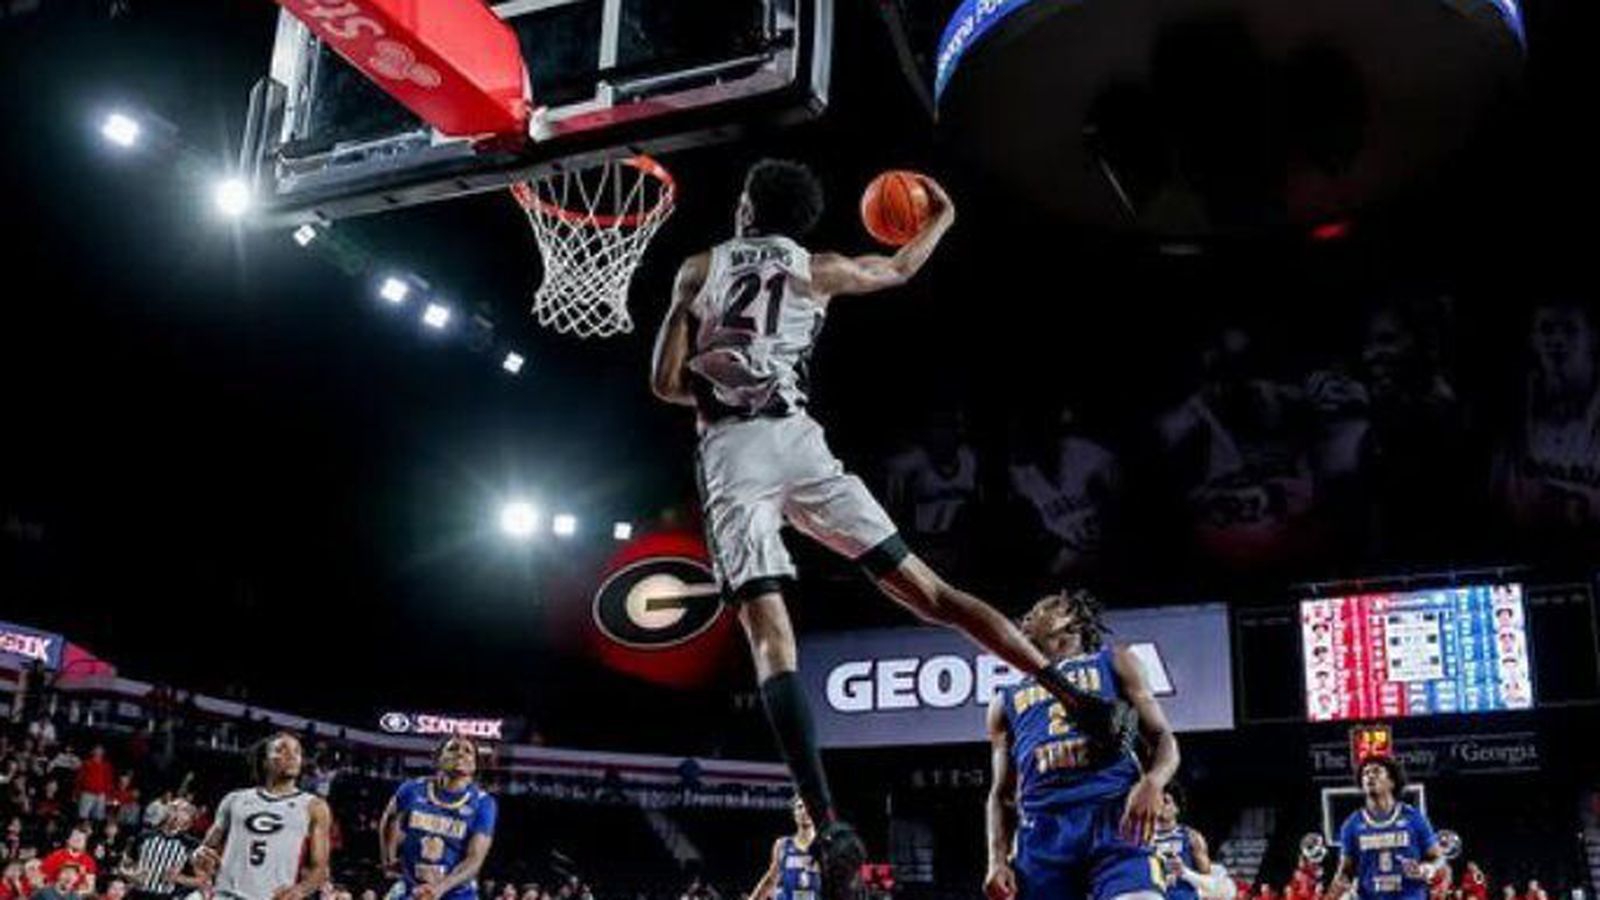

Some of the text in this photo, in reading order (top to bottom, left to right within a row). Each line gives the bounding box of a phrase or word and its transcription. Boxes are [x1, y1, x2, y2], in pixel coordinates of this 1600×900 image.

[721, 272, 787, 337] 21
[592, 557, 725, 647] G
[1461, 741, 1540, 763] Georgia
[245, 812, 284, 834] G
[249, 840, 268, 866] 5
